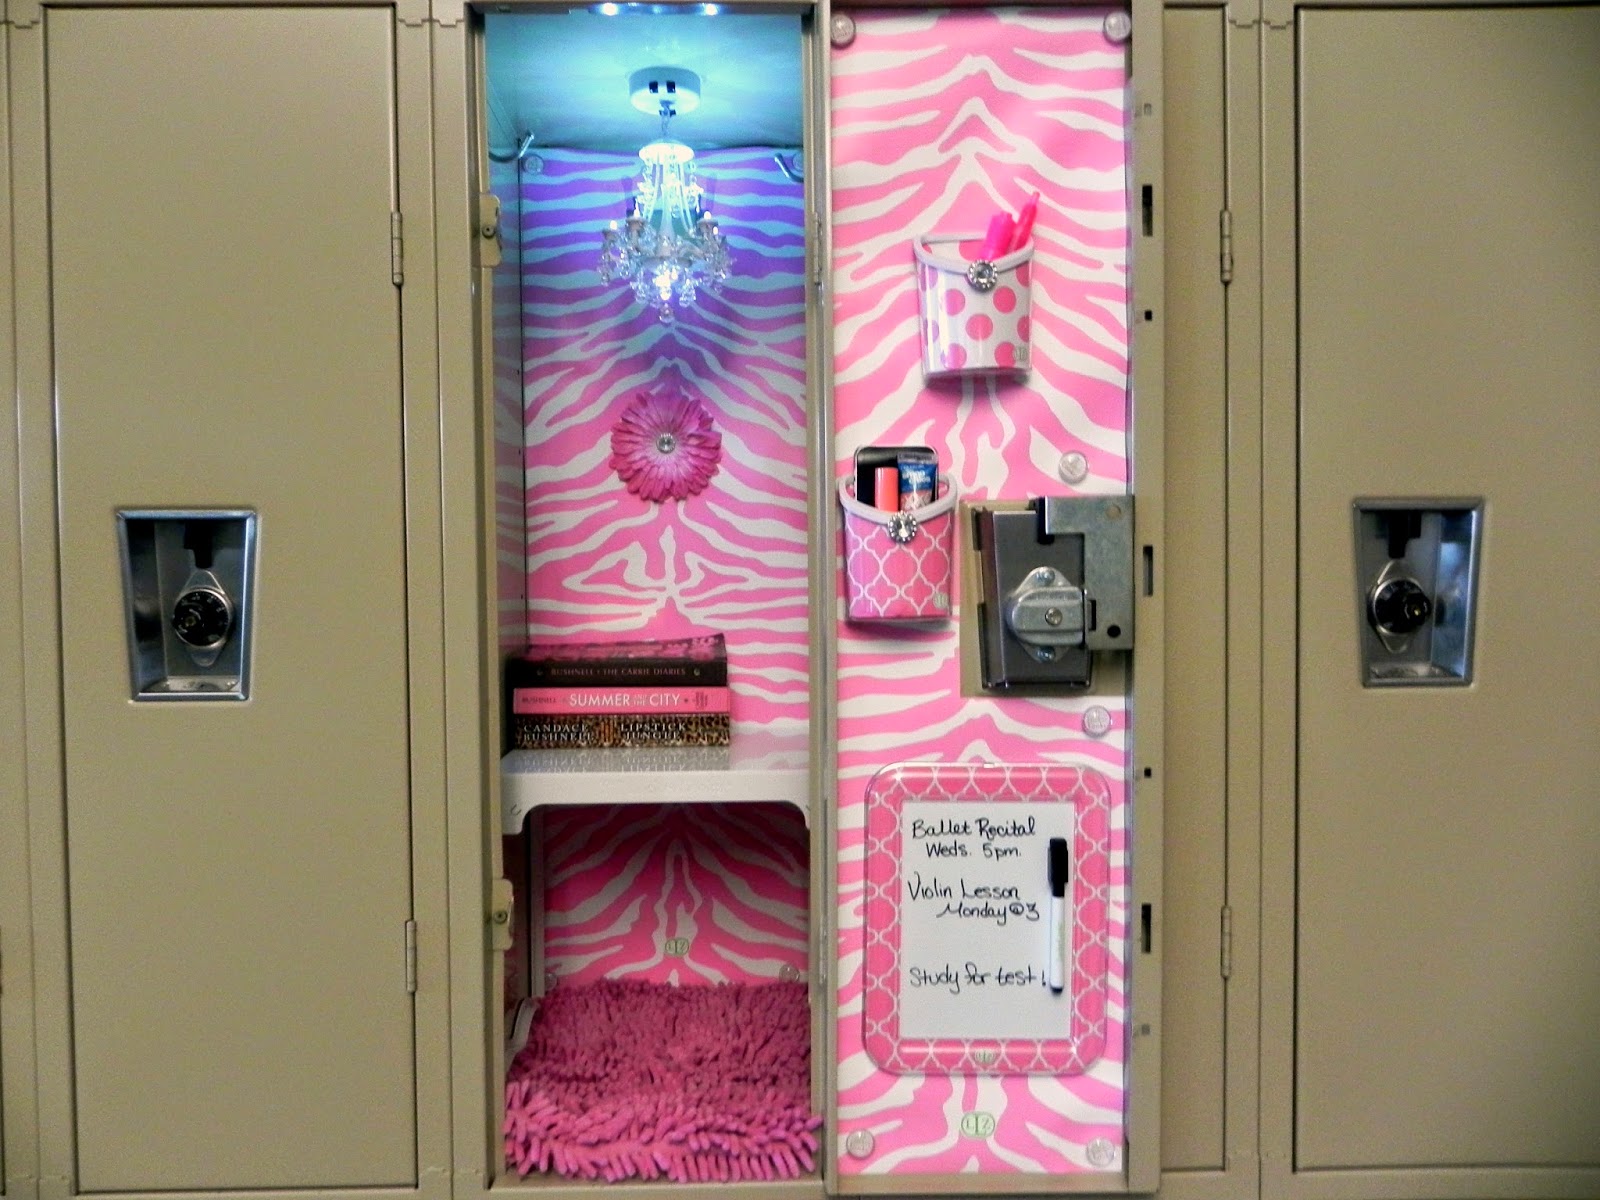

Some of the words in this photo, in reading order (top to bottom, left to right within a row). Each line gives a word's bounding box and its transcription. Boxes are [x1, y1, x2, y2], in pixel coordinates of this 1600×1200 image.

[603, 668, 618, 676] THE
[653, 668, 686, 676] DIARIES
[569, 693, 631, 707] SUMMER
[649, 693, 680, 707] CITY
[523, 724, 589, 733] CANDACE
[620, 722, 687, 732] LIPSTICK
[523, 732, 595, 741] BUSHNELL
[625, 731, 681, 740] JUNGLE
[912, 819, 972, 839] Ballet
[975, 815, 1036, 841] Recital
[926, 840, 972, 858] Weds.
[908, 871, 952, 901] Violin
[960, 878, 1021, 900] Lesson
[909, 964, 960, 995] Study
[964, 961, 991, 987] for
